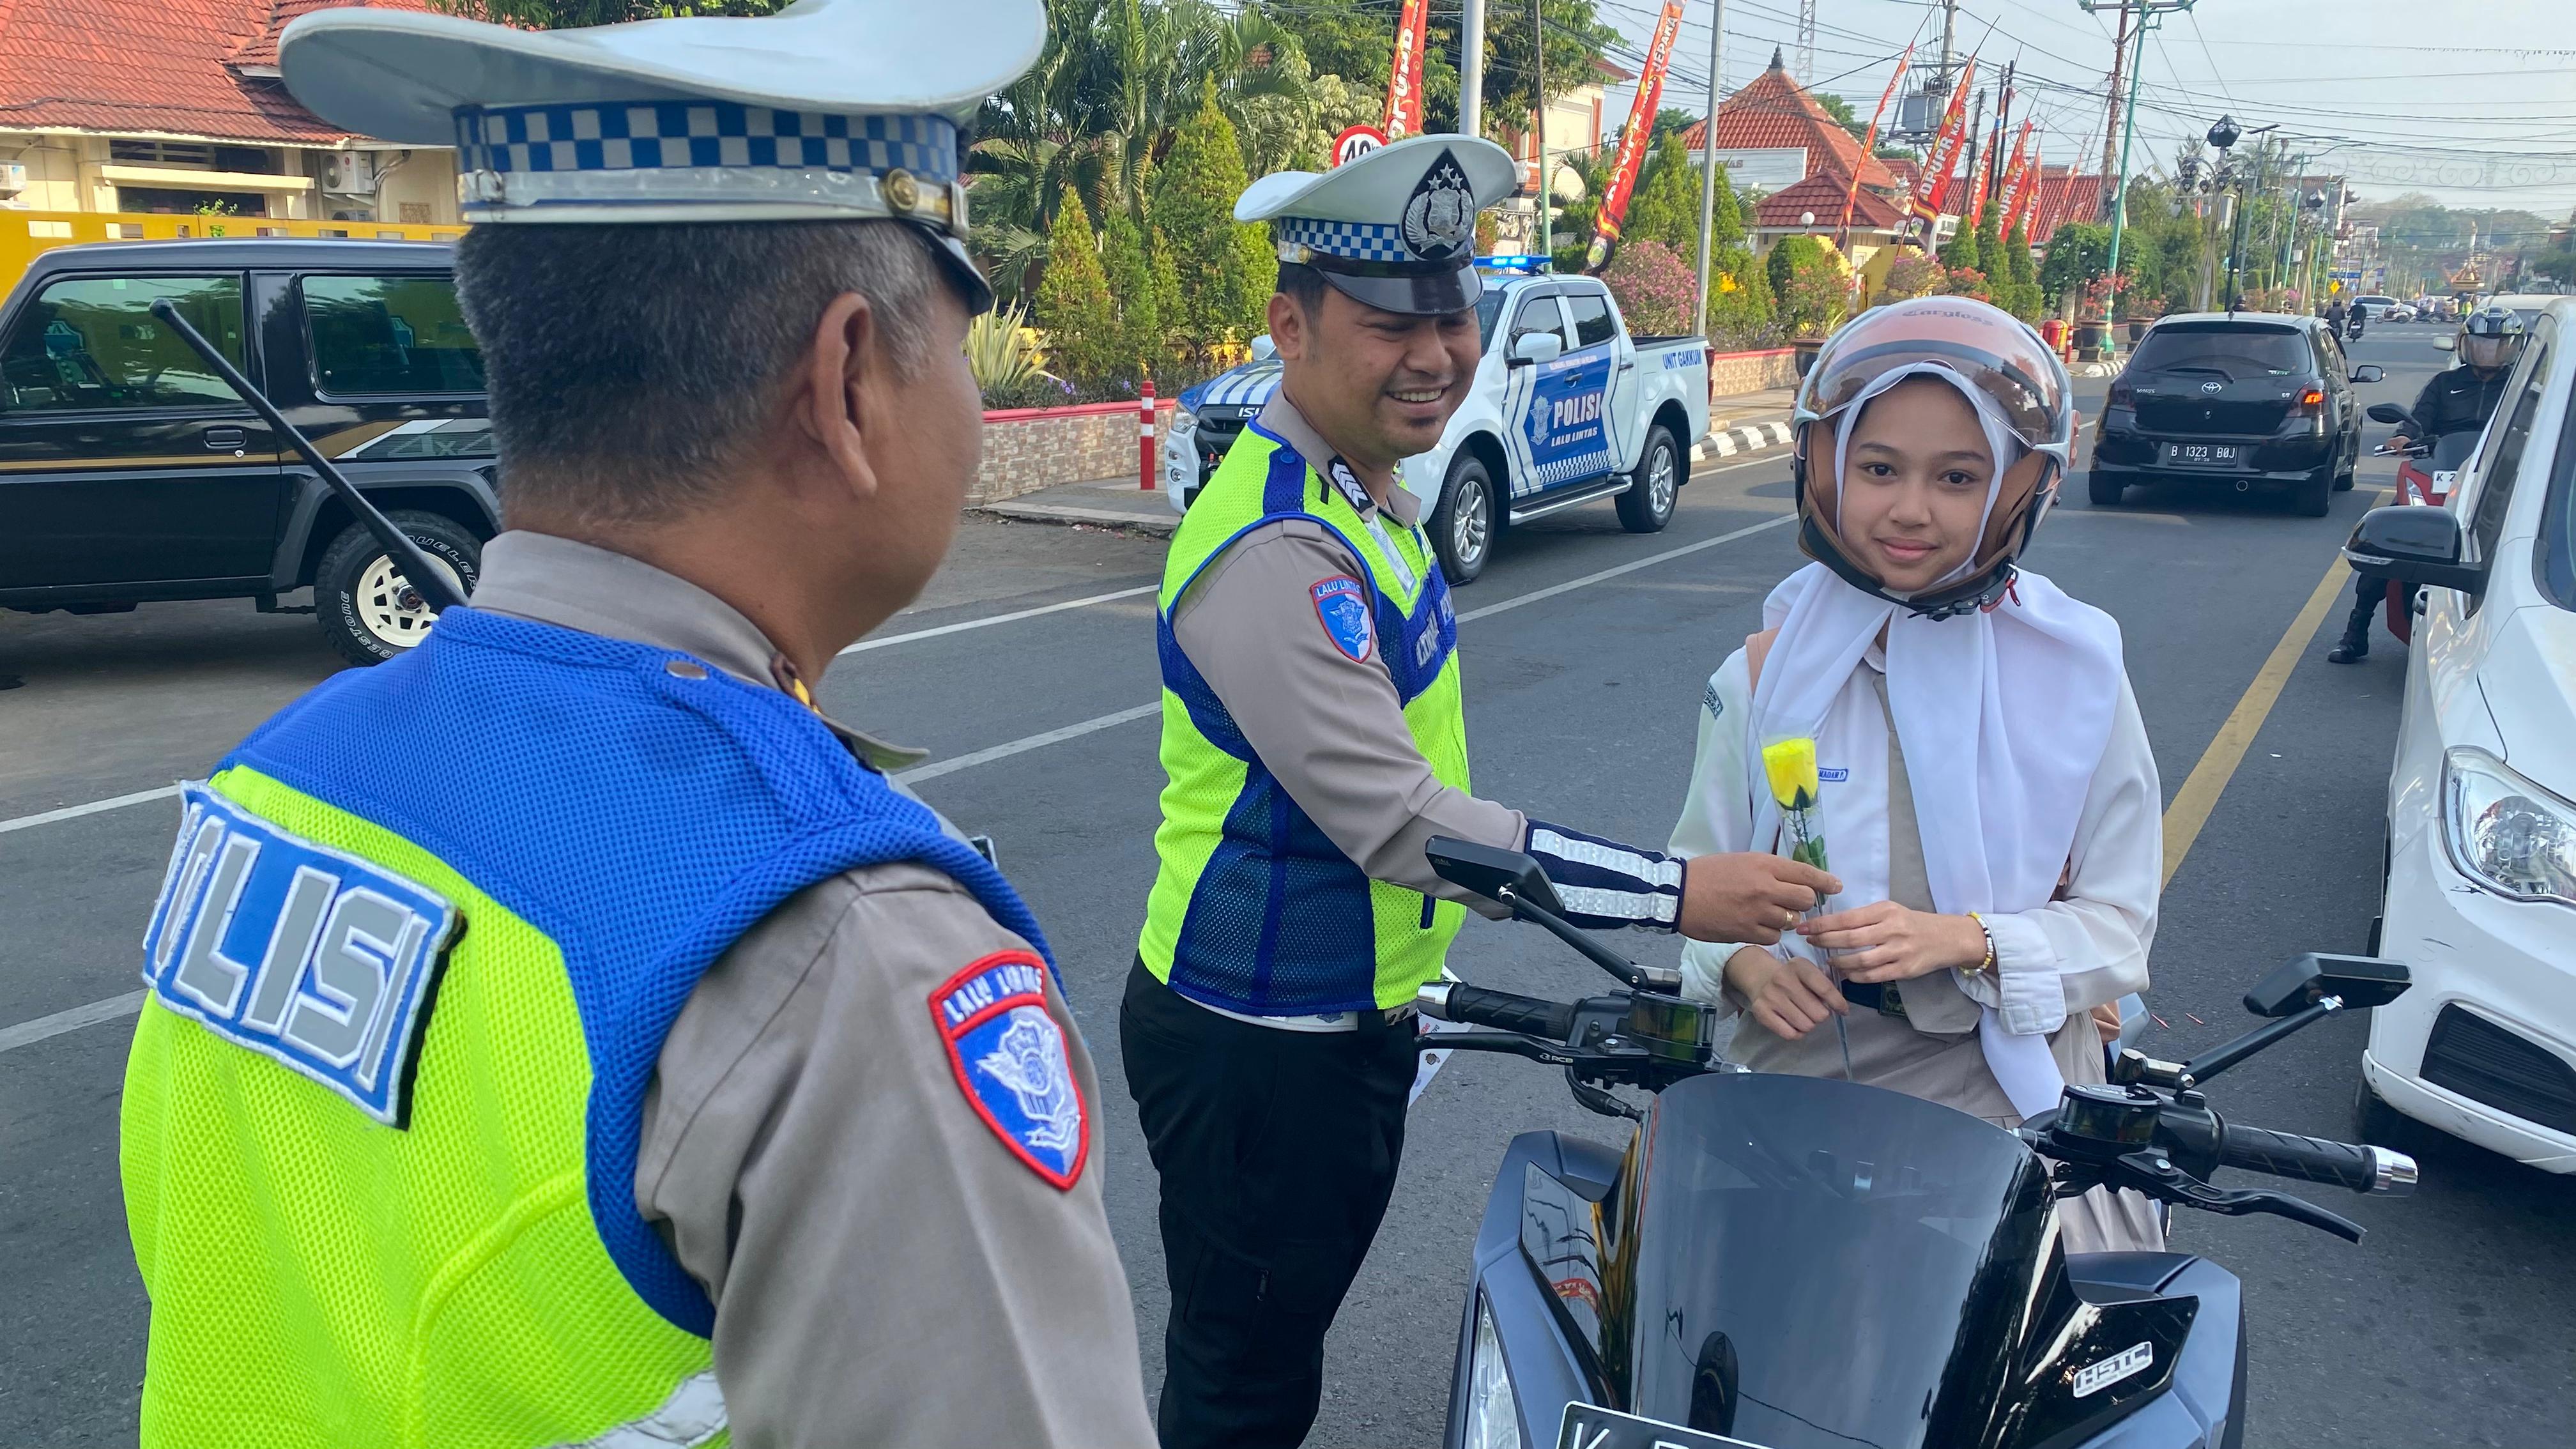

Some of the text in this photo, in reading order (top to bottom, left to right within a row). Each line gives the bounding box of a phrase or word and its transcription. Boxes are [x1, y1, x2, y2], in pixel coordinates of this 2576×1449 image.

[1652, 15, 1679, 75] JEPARA
[1344, 140, 1370, 163] 40
[1920, 136, 1955, 195] DPUPR
[1662, 349, 1702, 370] UNIT GAKKUM
[1238, 407, 1264, 417] ISU
[1553, 393, 1602, 429] POLISI
[1551, 426, 1598, 447] LALU LINTAS
[2171, 445, 2178, 457] B
[2186, 446, 2208, 457] 1323
[2436, 473, 2456, 482] K 2
[1316, 579, 1361, 597] LALU LINTAS
[341, 590, 394, 659] GESTONE
[143, 802, 433, 1094] OLISI
[942, 975, 994, 1023] LALU
[2077, 1344, 2150, 1388] HSTC
